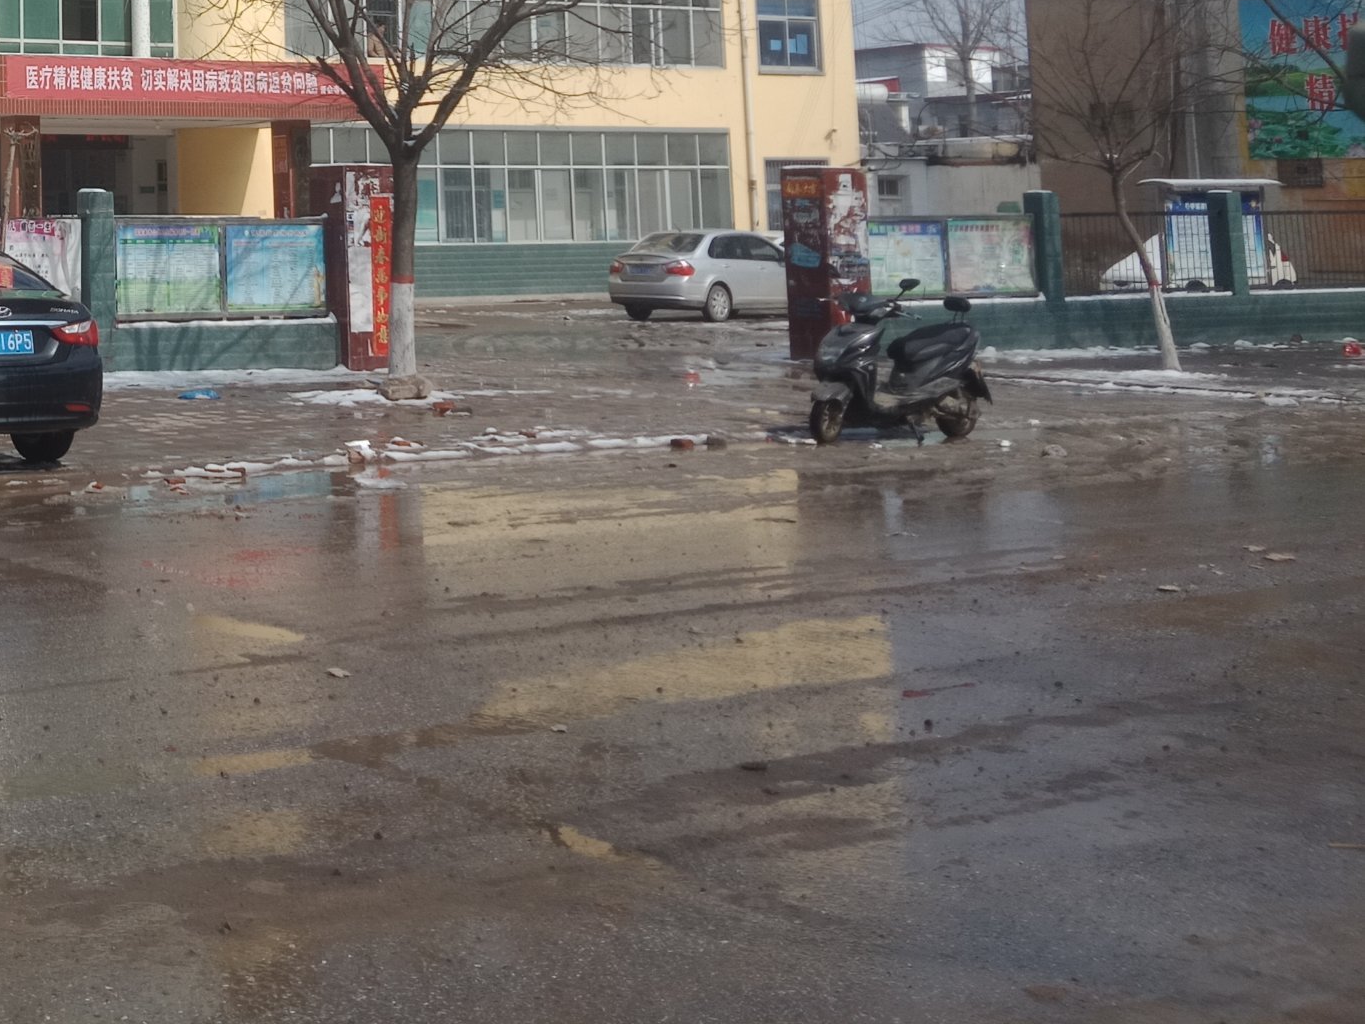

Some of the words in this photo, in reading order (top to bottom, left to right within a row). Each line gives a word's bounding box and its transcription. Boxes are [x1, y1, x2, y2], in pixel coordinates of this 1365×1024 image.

[25, 64, 134, 91] 医疗精准健康扶贫
[140, 67, 318, 95] 切实解决因病致贫因病返贫问题
